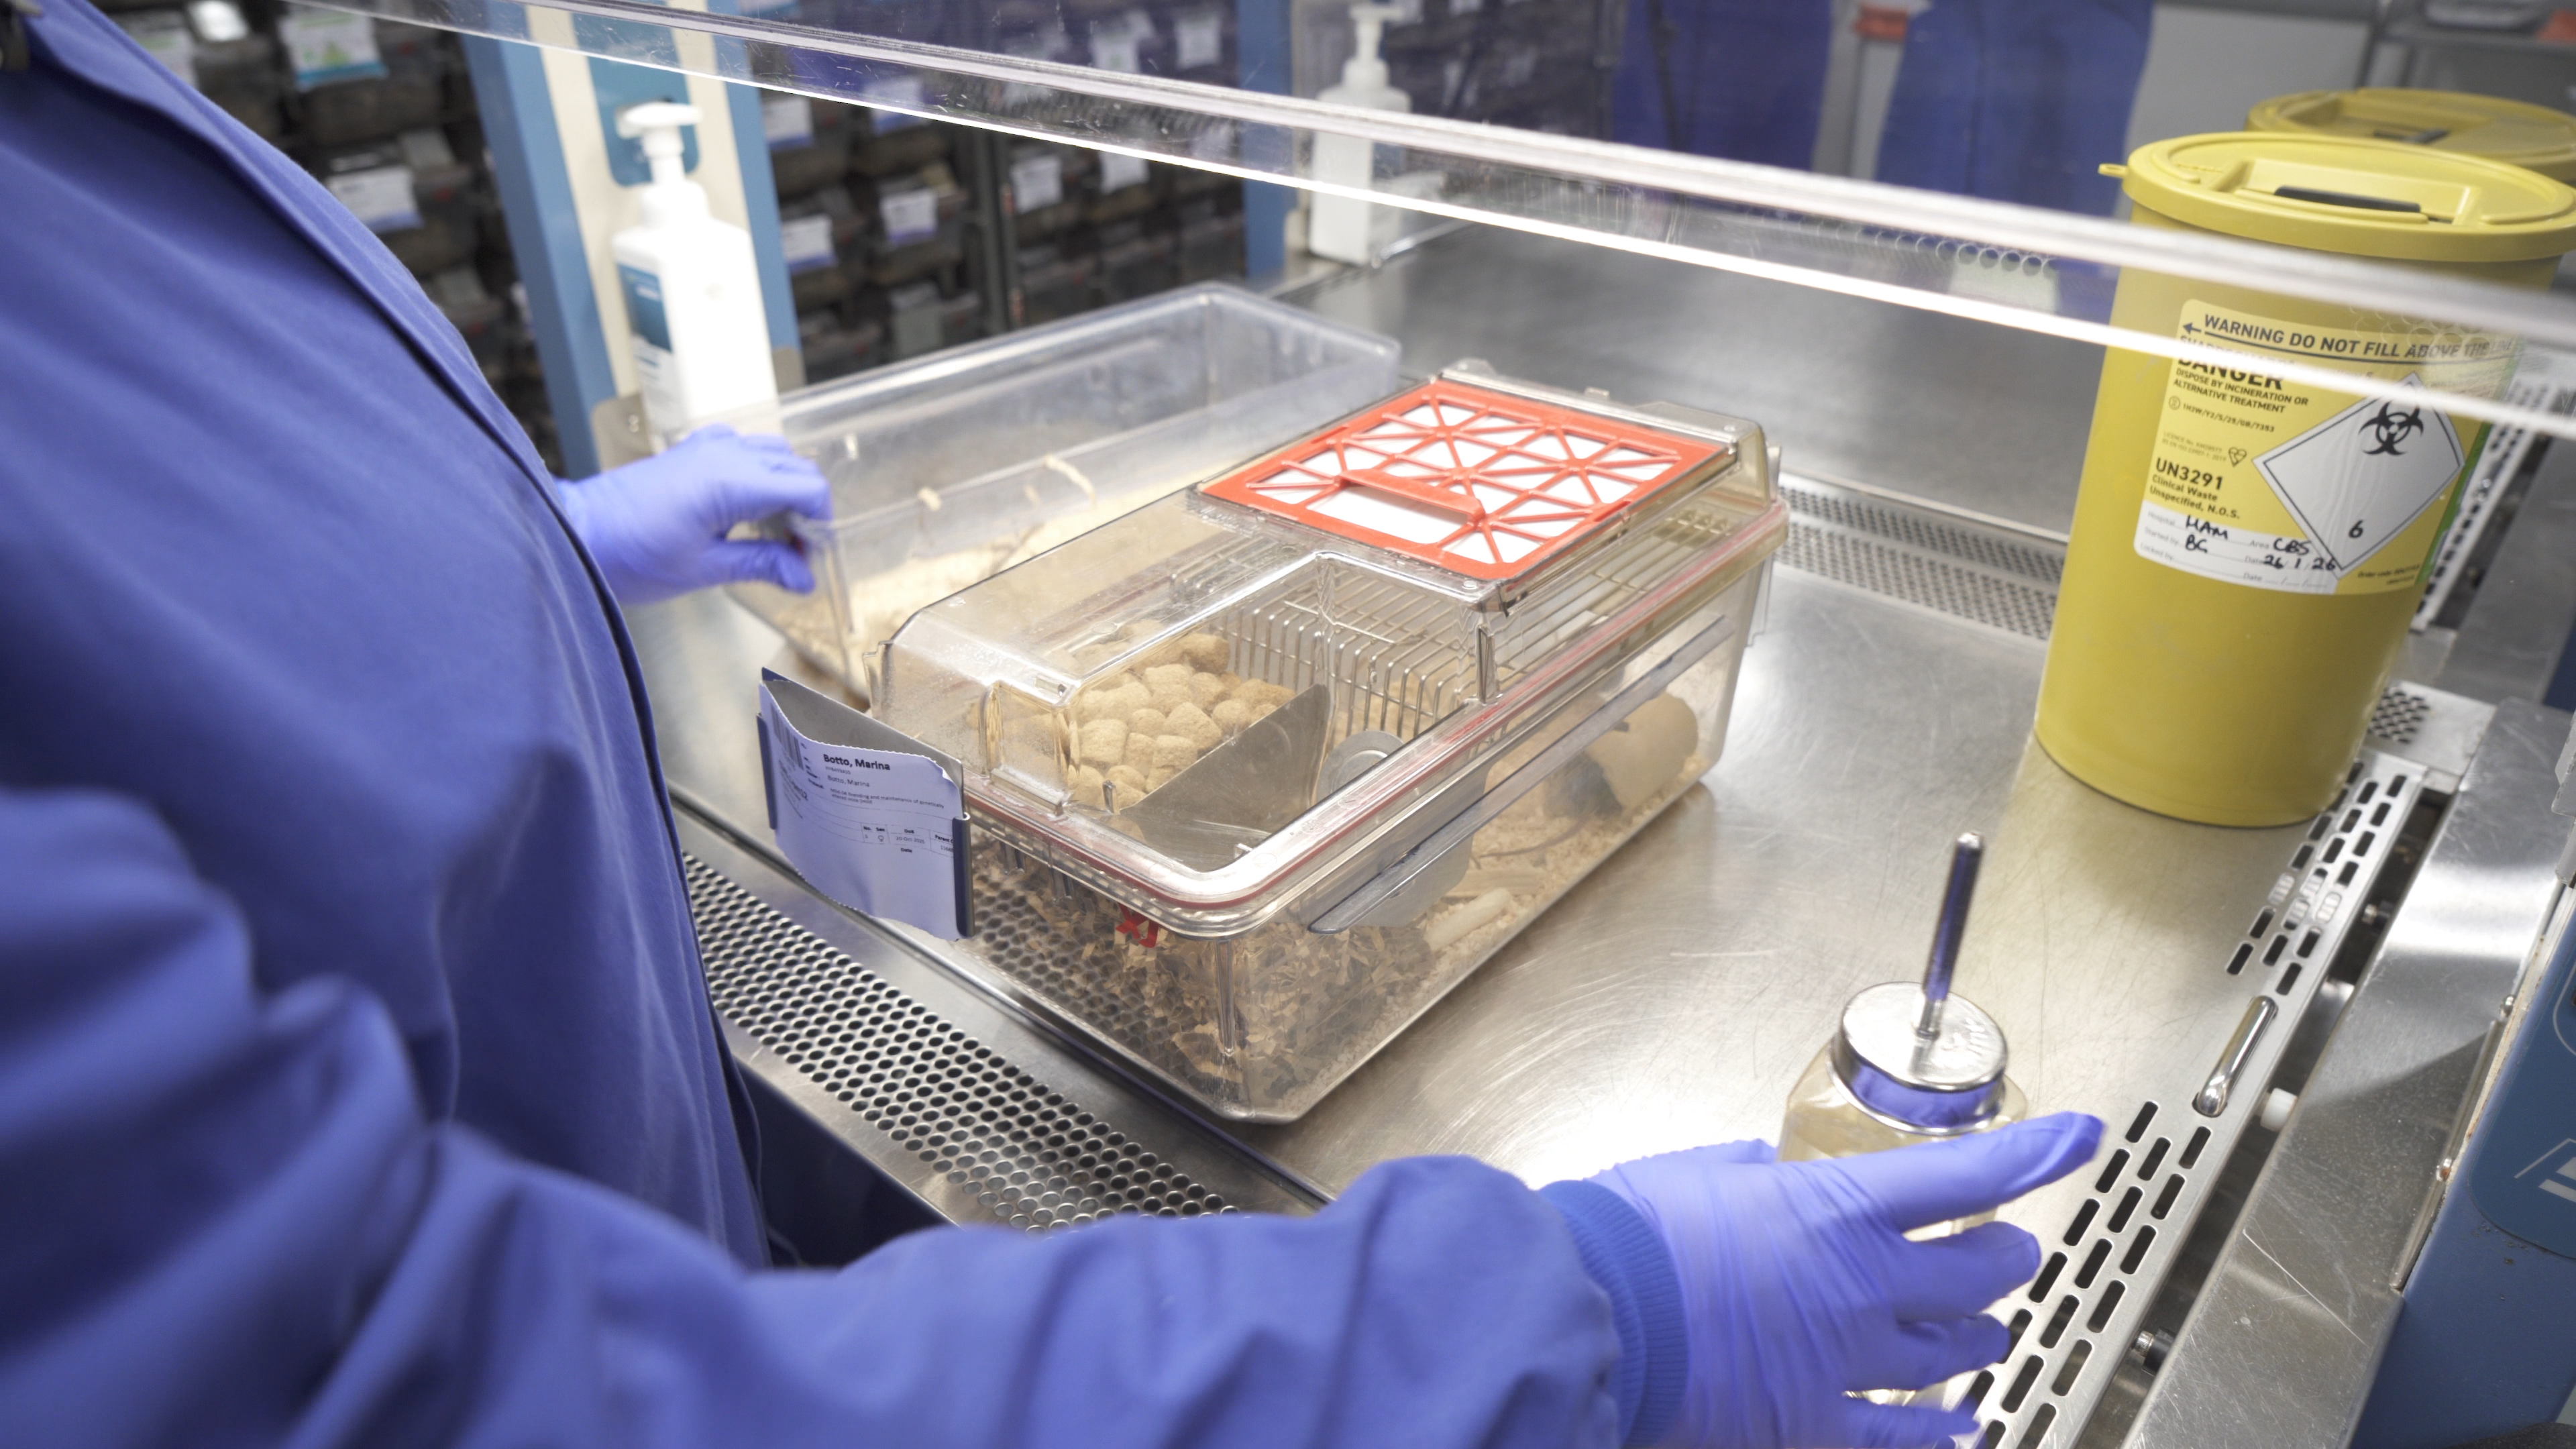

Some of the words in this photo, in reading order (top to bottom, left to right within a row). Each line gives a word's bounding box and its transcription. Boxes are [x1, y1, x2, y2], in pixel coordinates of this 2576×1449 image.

[2204, 313, 2285, 343] WARNING
[2289, 332, 2316, 349] DO
[2320, 337, 2361, 354] NOT
[2363, 341, 2400, 358] FILL
[2404, 343, 2461, 358] ABOVE
[2463, 342, 2490, 357] THE
[2173, 379, 2228, 402] ALTERNATIVE
[2229, 393, 2286, 413] TREATMENT
[2176, 368, 2210, 386] DISPOSE
[2210, 379, 2224, 389] BY
[2224, 381, 2293, 405] INCINERATION
[2294, 396, 2309, 406] OR
[2155, 457, 2223, 490] UN3291
[2152, 474, 2185, 492] Clinical
[2187, 486, 2218, 502] Waste
[2149, 485, 2204, 512] Unspecified,
[2207, 504, 2241, 520] N.O.S.
[2349, 520, 2364, 539] 6
[2249, 540, 2269, 549] Area
[2243, 572, 2263, 582] Date
[822, 753, 853, 768] Botto,
[854, 758, 891, 771] Marina
[827, 774, 847, 785] Botto,
[847, 779, 871, 788] Marina
[934, 834, 950, 843] Parent
